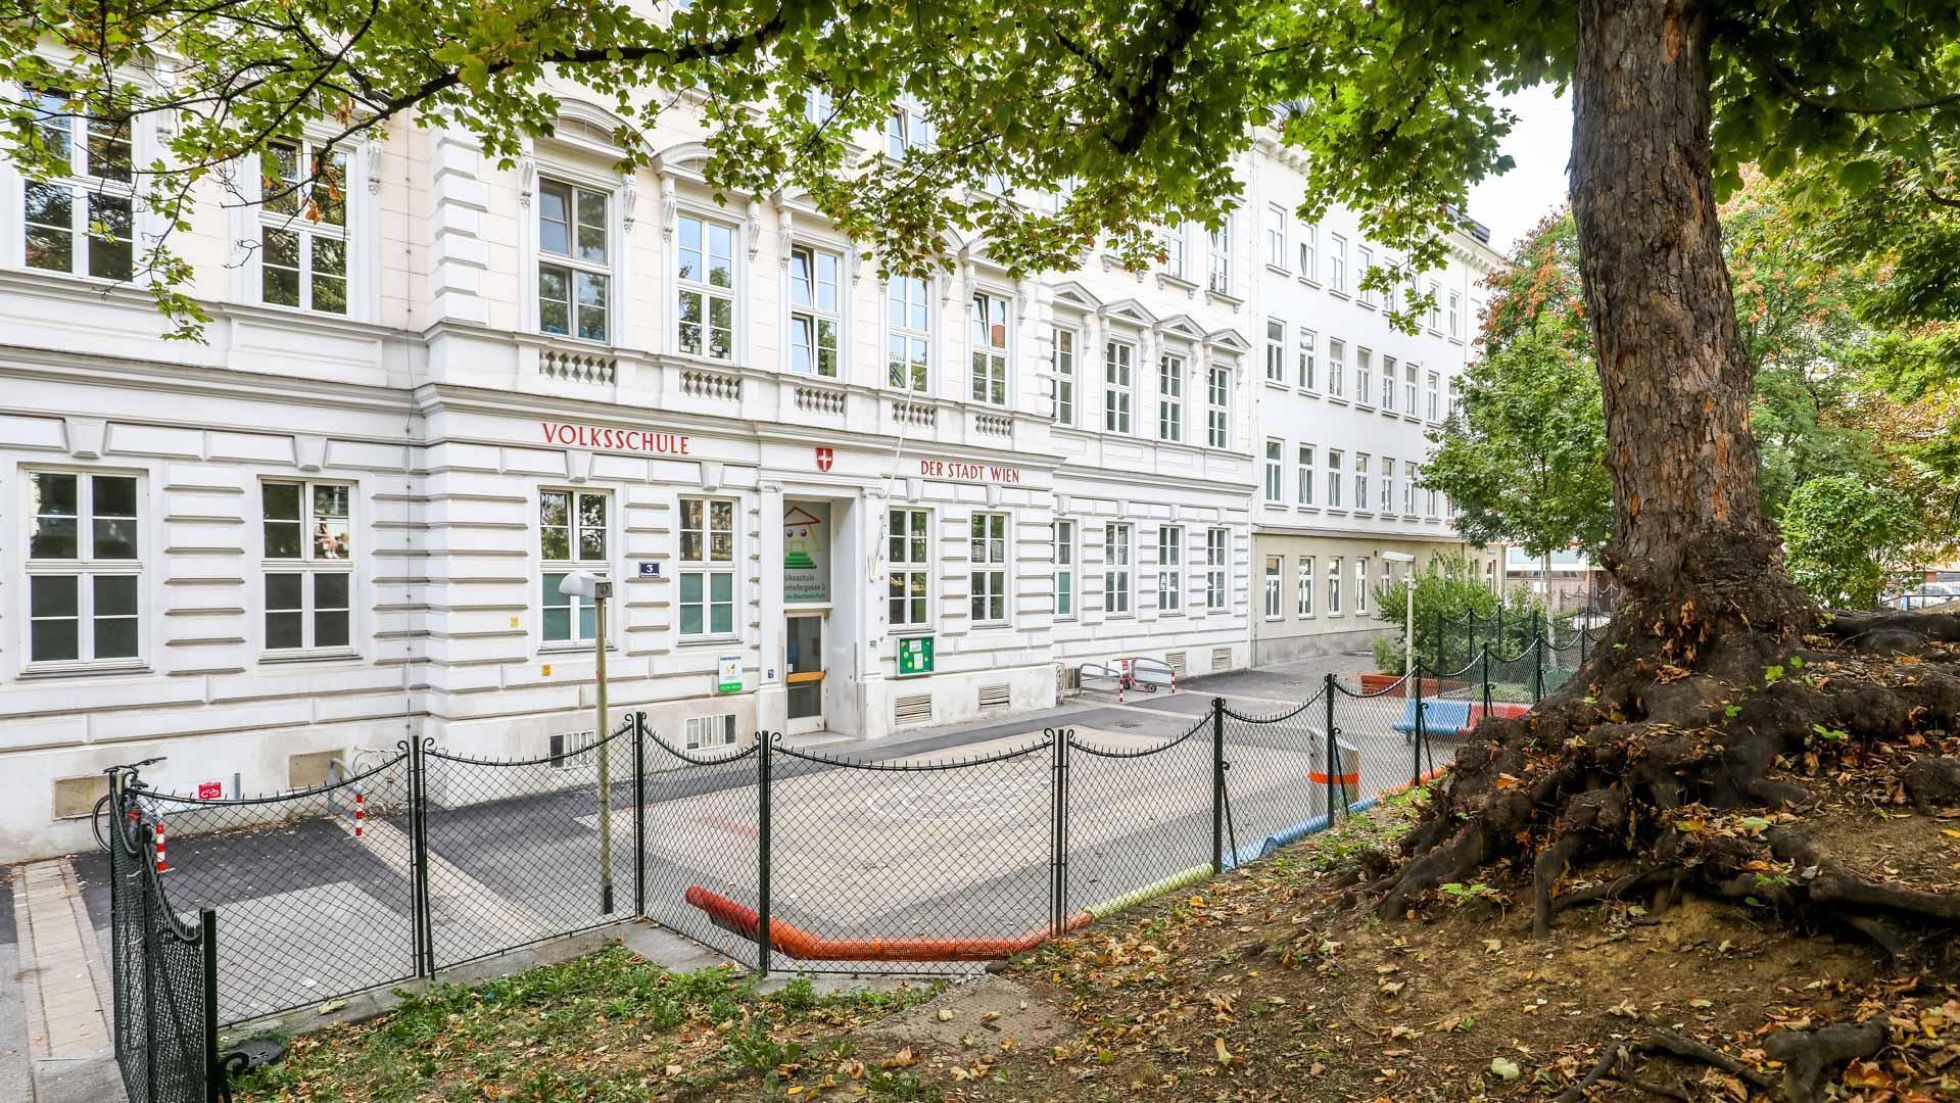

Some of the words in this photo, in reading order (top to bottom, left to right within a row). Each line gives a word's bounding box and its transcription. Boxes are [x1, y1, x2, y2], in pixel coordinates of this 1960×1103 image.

[542, 423, 689, 455] VOLKSSCHULE
[921, 460, 943, 476] DER
[948, 463, 985, 480] STADT
[991, 467, 1019, 482] WIEN
[646, 564, 653, 572] 3
